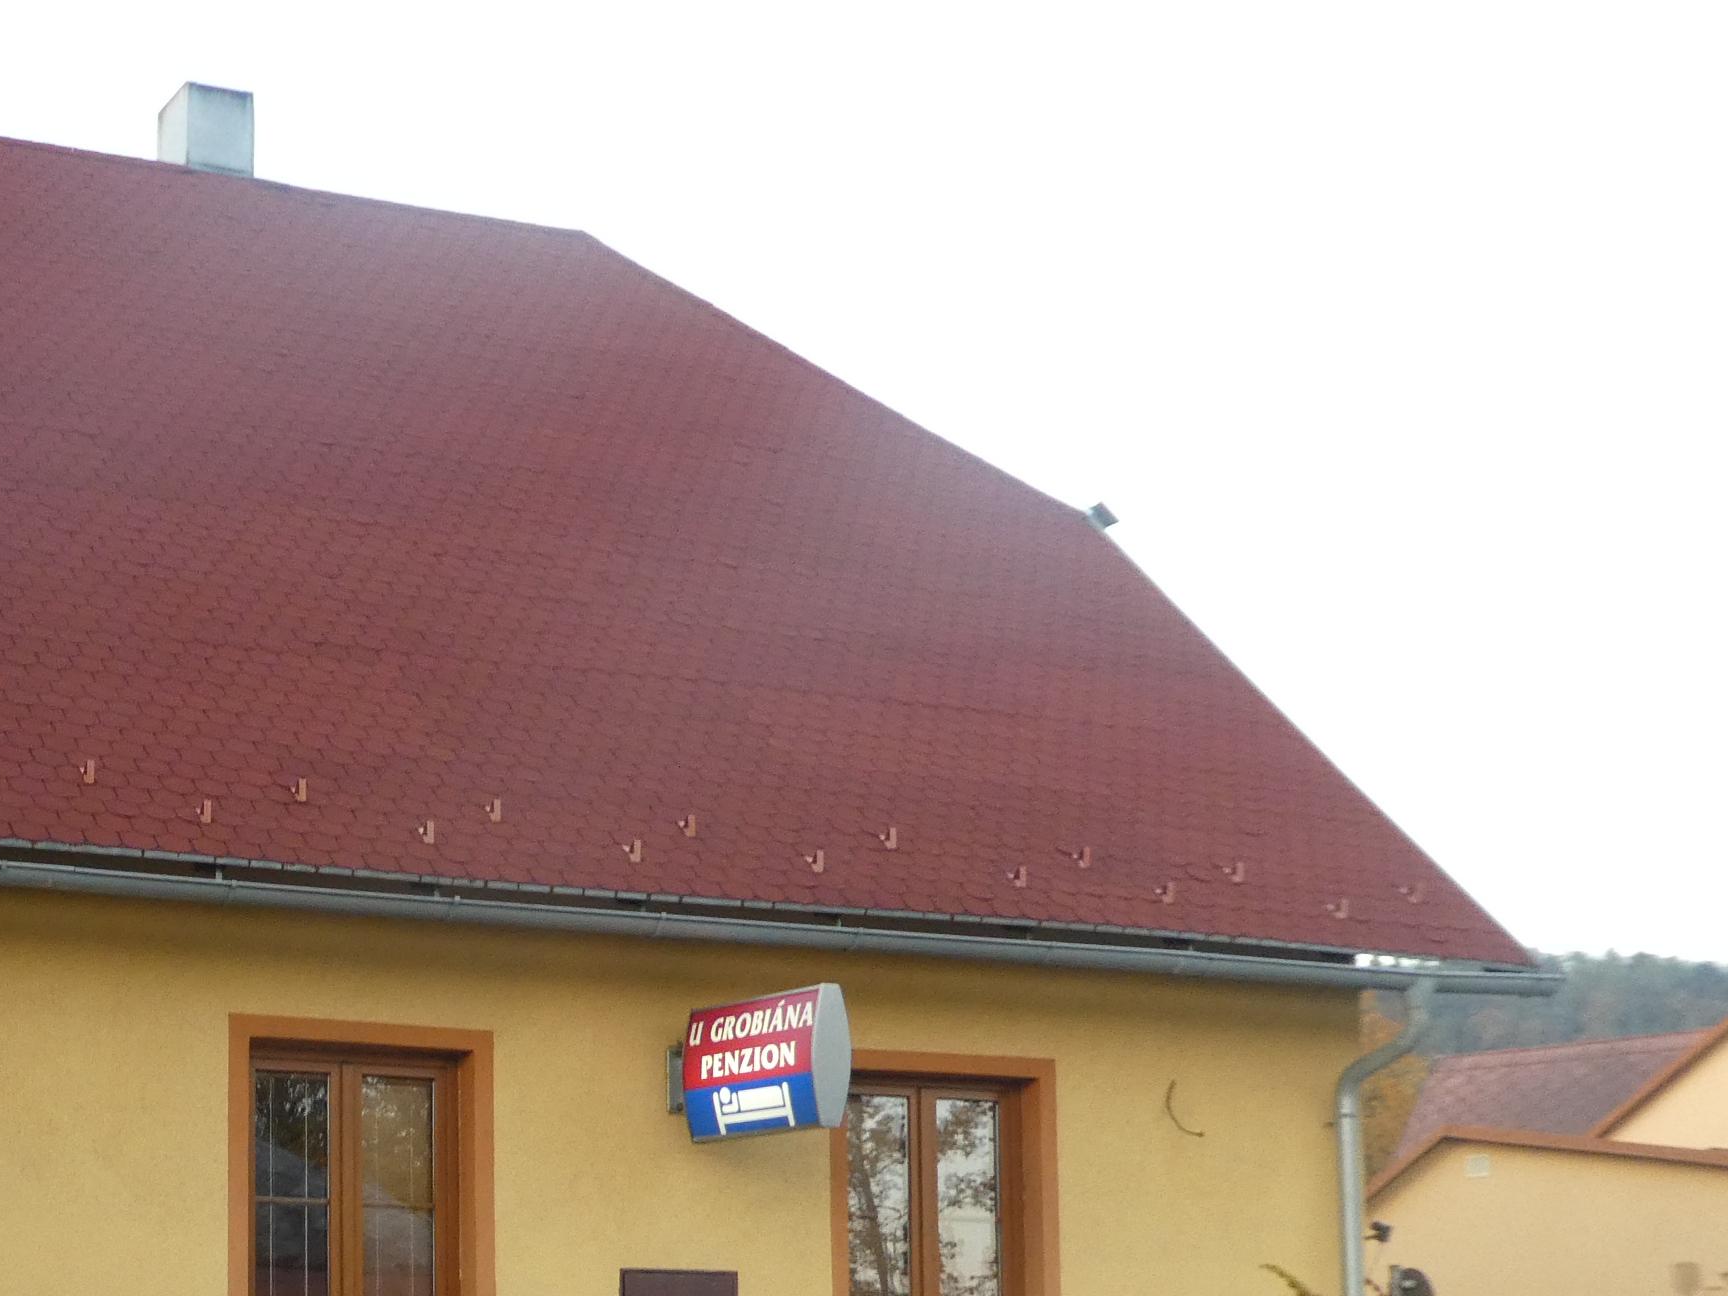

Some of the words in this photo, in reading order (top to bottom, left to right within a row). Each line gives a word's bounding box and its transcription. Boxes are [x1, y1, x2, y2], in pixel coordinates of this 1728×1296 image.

[689, 1022, 704, 1047] U
[710, 999, 813, 1043] GROBIÁNA
[700, 1041, 796, 1080] PENZION
